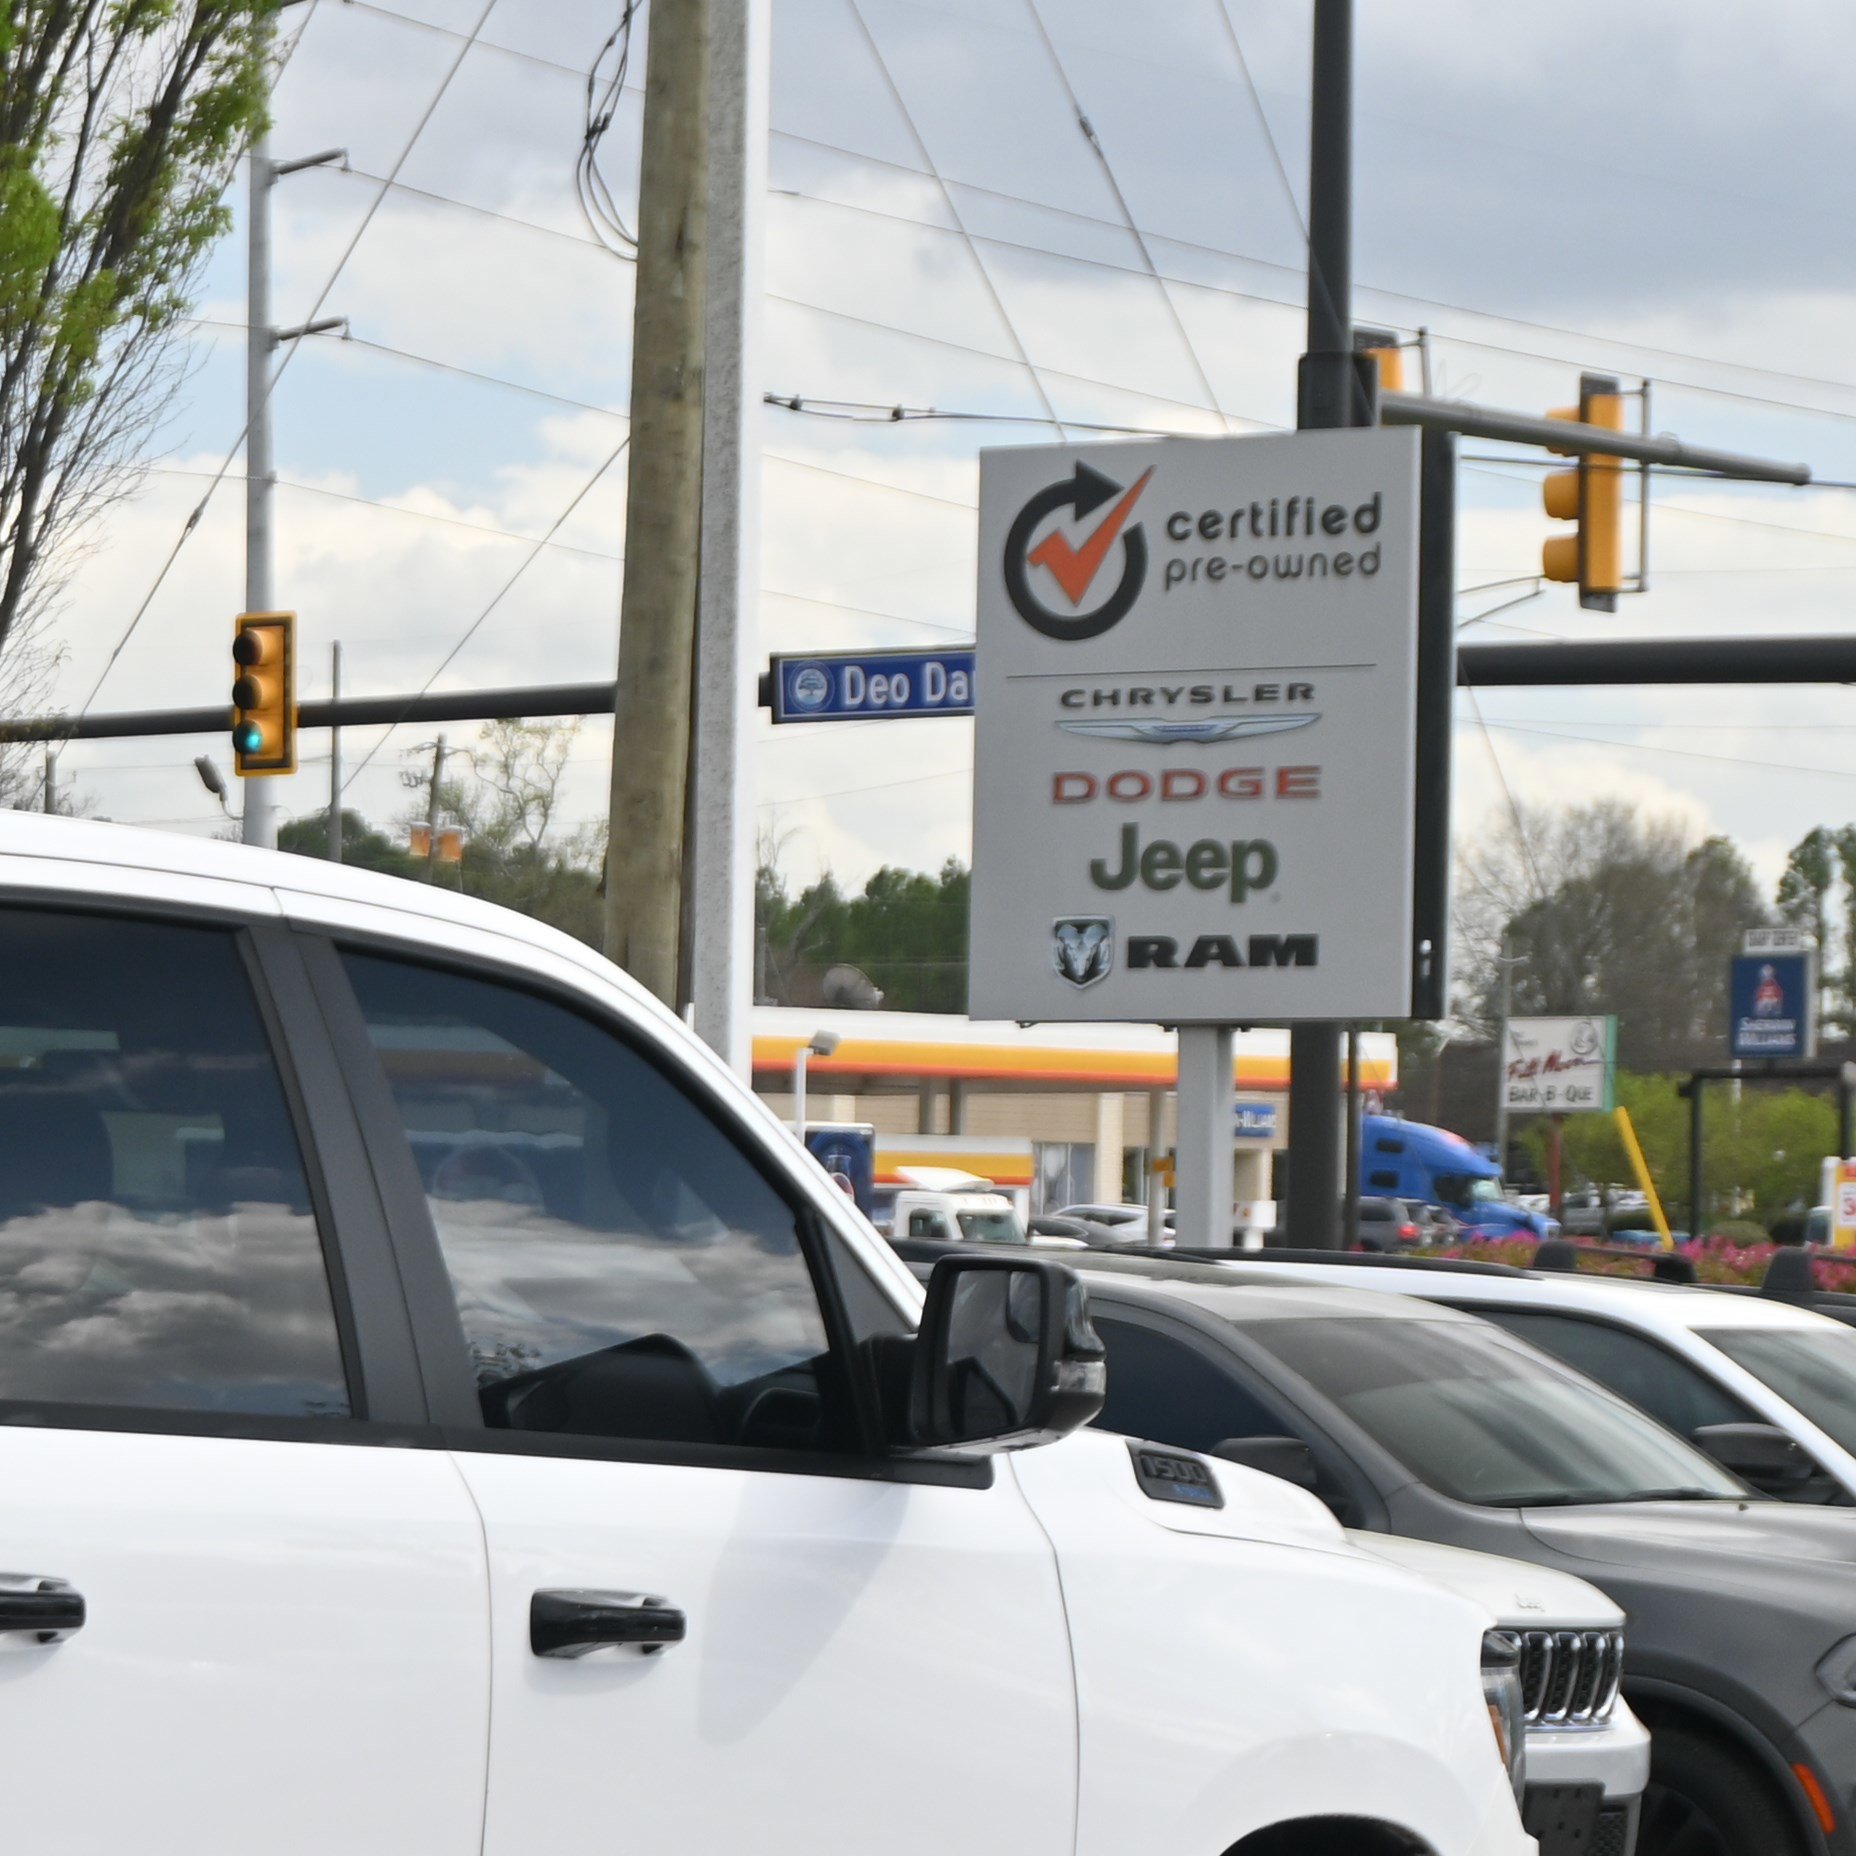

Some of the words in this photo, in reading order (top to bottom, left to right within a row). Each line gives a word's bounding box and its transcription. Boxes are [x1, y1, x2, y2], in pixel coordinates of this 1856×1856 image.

[1166, 491, 1383, 541] certified
[1164, 541, 1382, 592] pre-owned
[843, 664, 911, 705] Deo
[924, 661, 976, 702] Da
[1060, 682, 1316, 708] CHRYSLER
[1052, 765, 1322, 804] DODGE
[1090, 821, 1279, 903] Jeep
[1127, 933, 1320, 969] RAM
